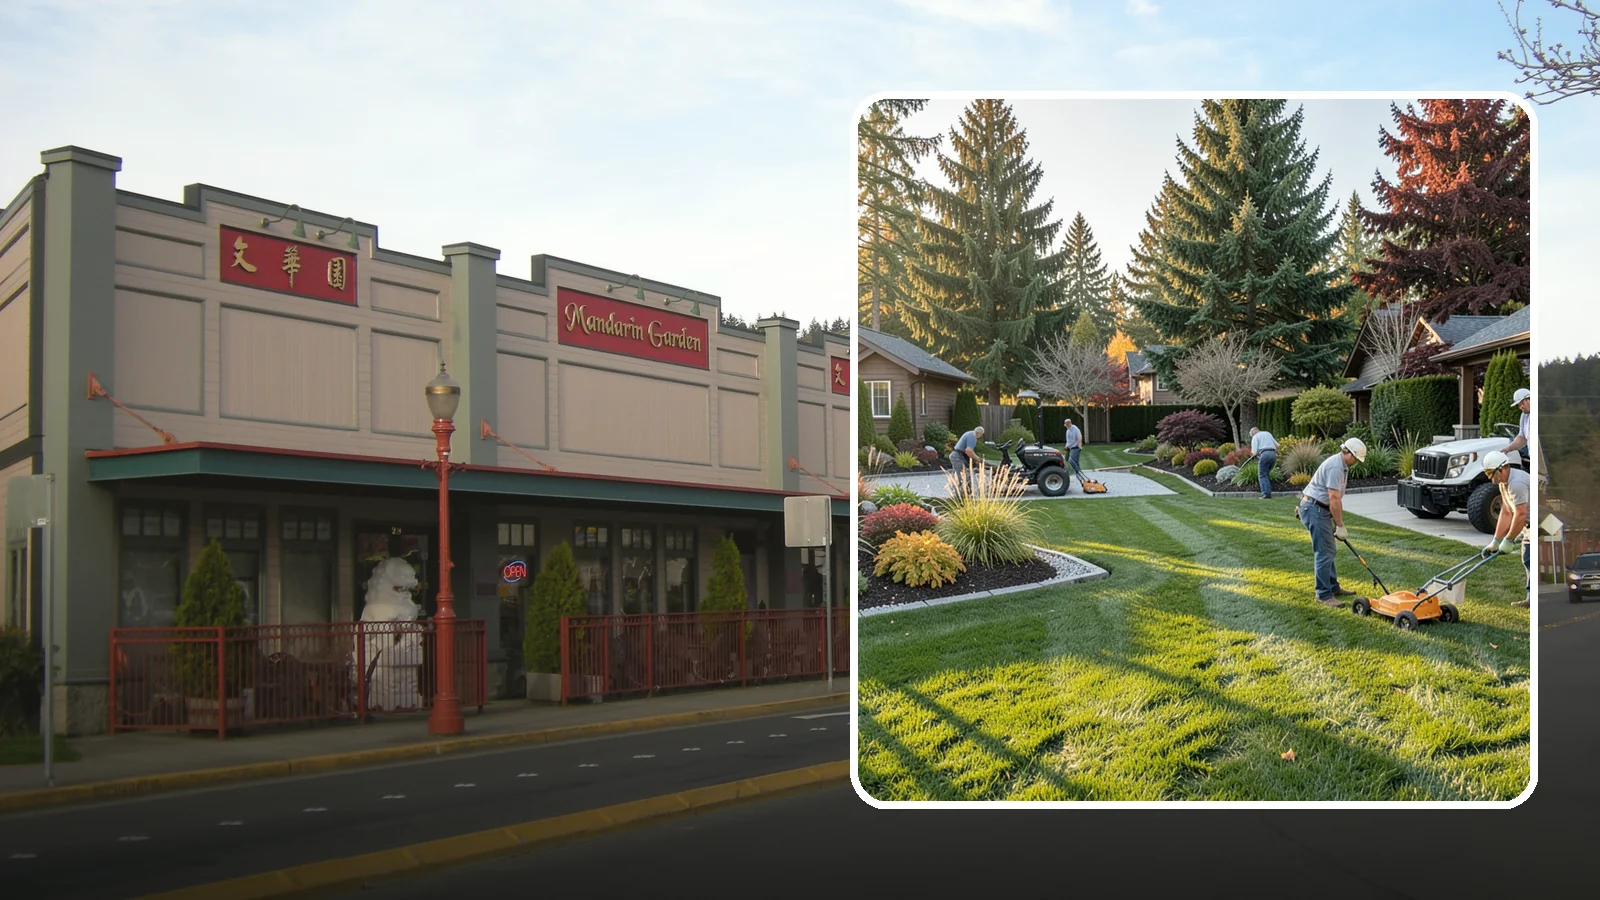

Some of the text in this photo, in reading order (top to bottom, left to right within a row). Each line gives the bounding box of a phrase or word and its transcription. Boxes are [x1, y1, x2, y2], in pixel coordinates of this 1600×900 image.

[231, 236, 346, 290] 文華園
[564, 302, 702, 352] Mandarin Garden
[503, 565, 526, 578] OPEN
